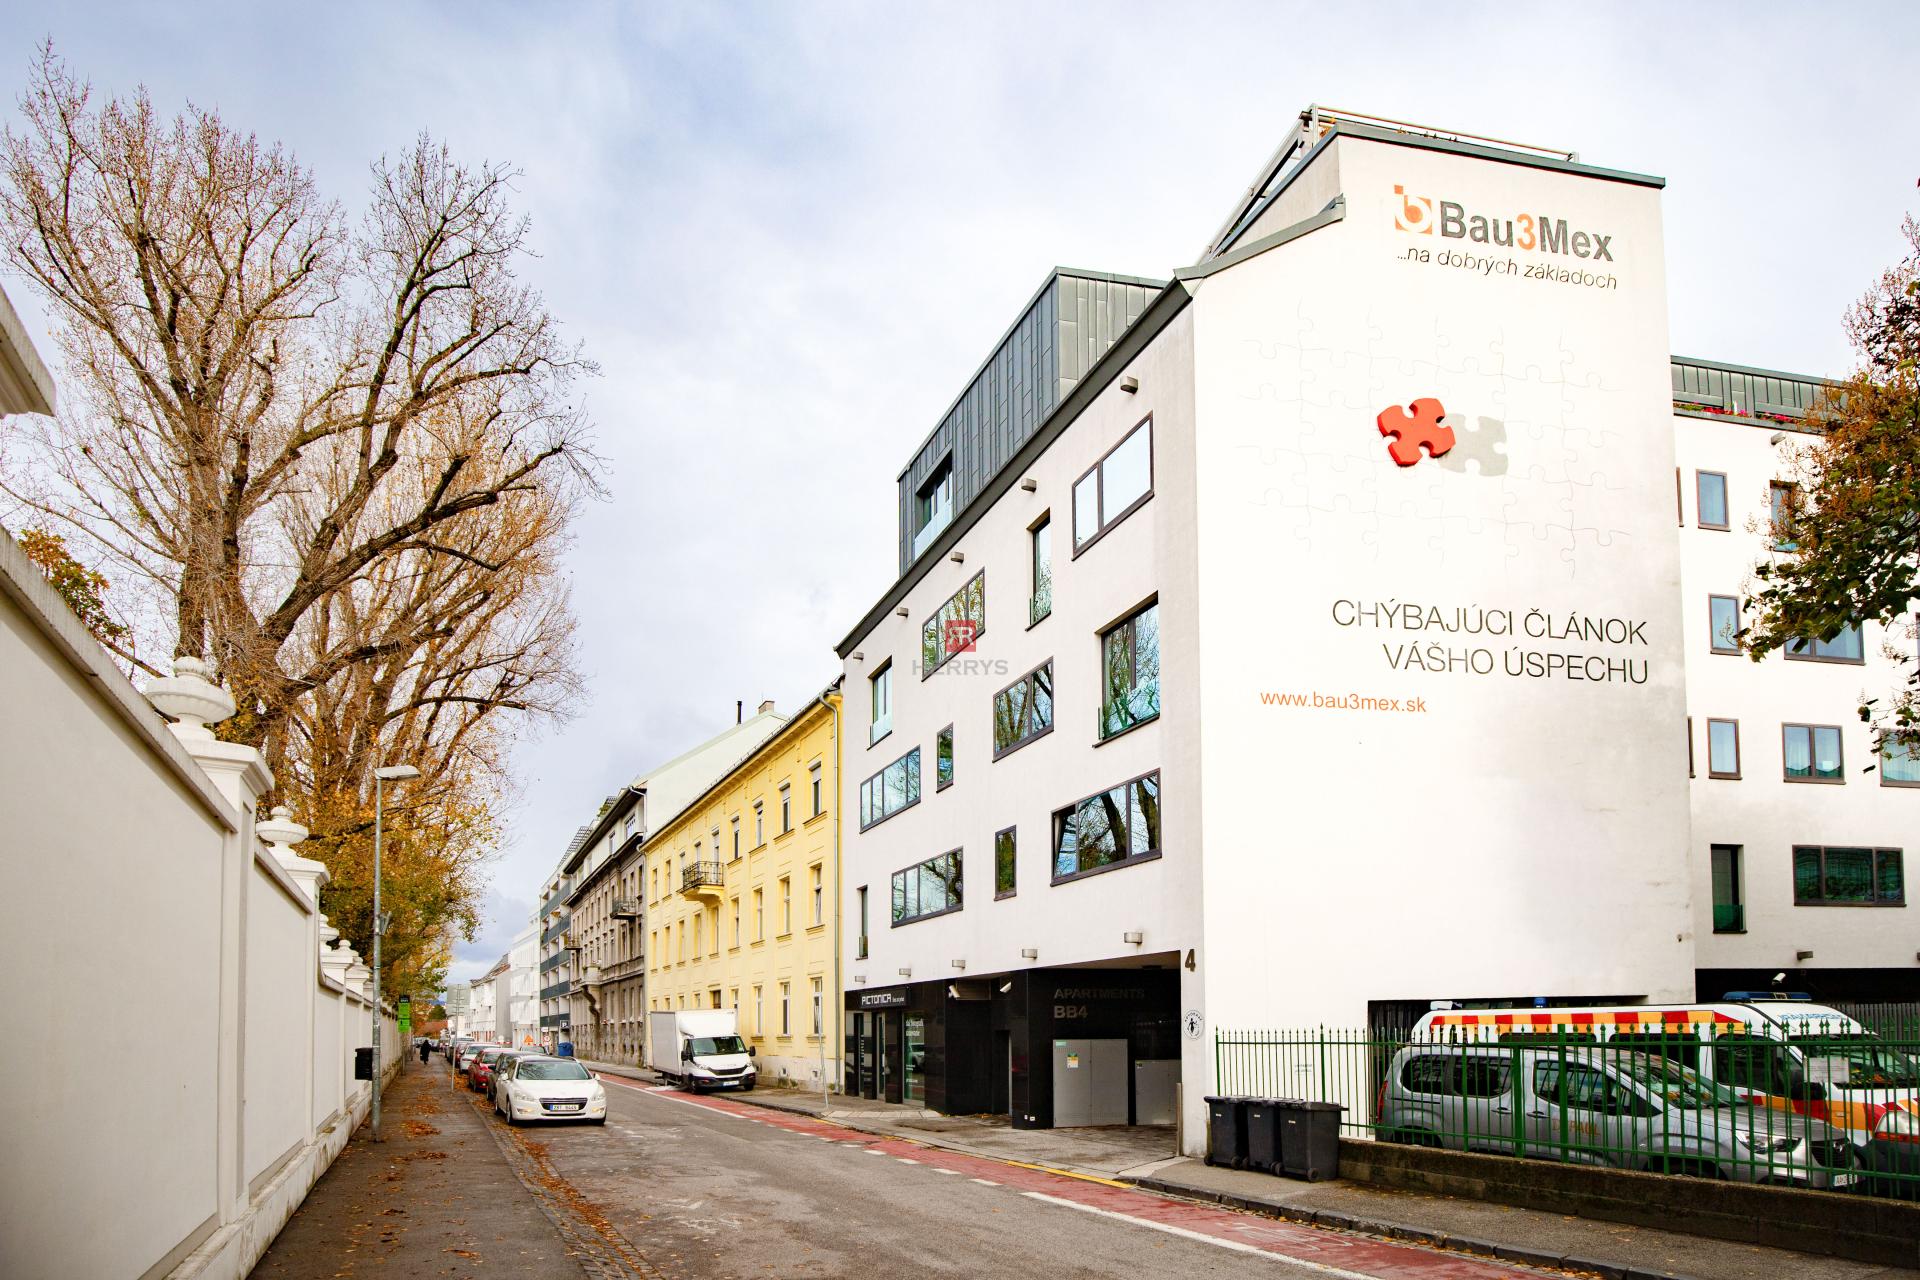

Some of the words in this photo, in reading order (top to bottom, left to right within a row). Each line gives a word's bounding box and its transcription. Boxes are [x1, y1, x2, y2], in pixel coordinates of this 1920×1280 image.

[1439, 200, 1614, 262] Bau3Mex
[1437, 249, 1518, 276] dobrých
[1524, 262, 1617, 290] základoch
[1332, 598, 1514, 636] CHÝBAJÚCI
[1523, 607, 1648, 646] ČLÁNOK
[1382, 640, 1494, 676] VÁŠHO
[1504, 649, 1649, 685] ÚSPECHU
[1260, 690, 1427, 713] www.bau3mex.sk
[1184, 948, 1196, 972] 4
[1054, 988, 1145, 999] APARTMENTS
[1054, 1005, 1088, 1019] BB4
